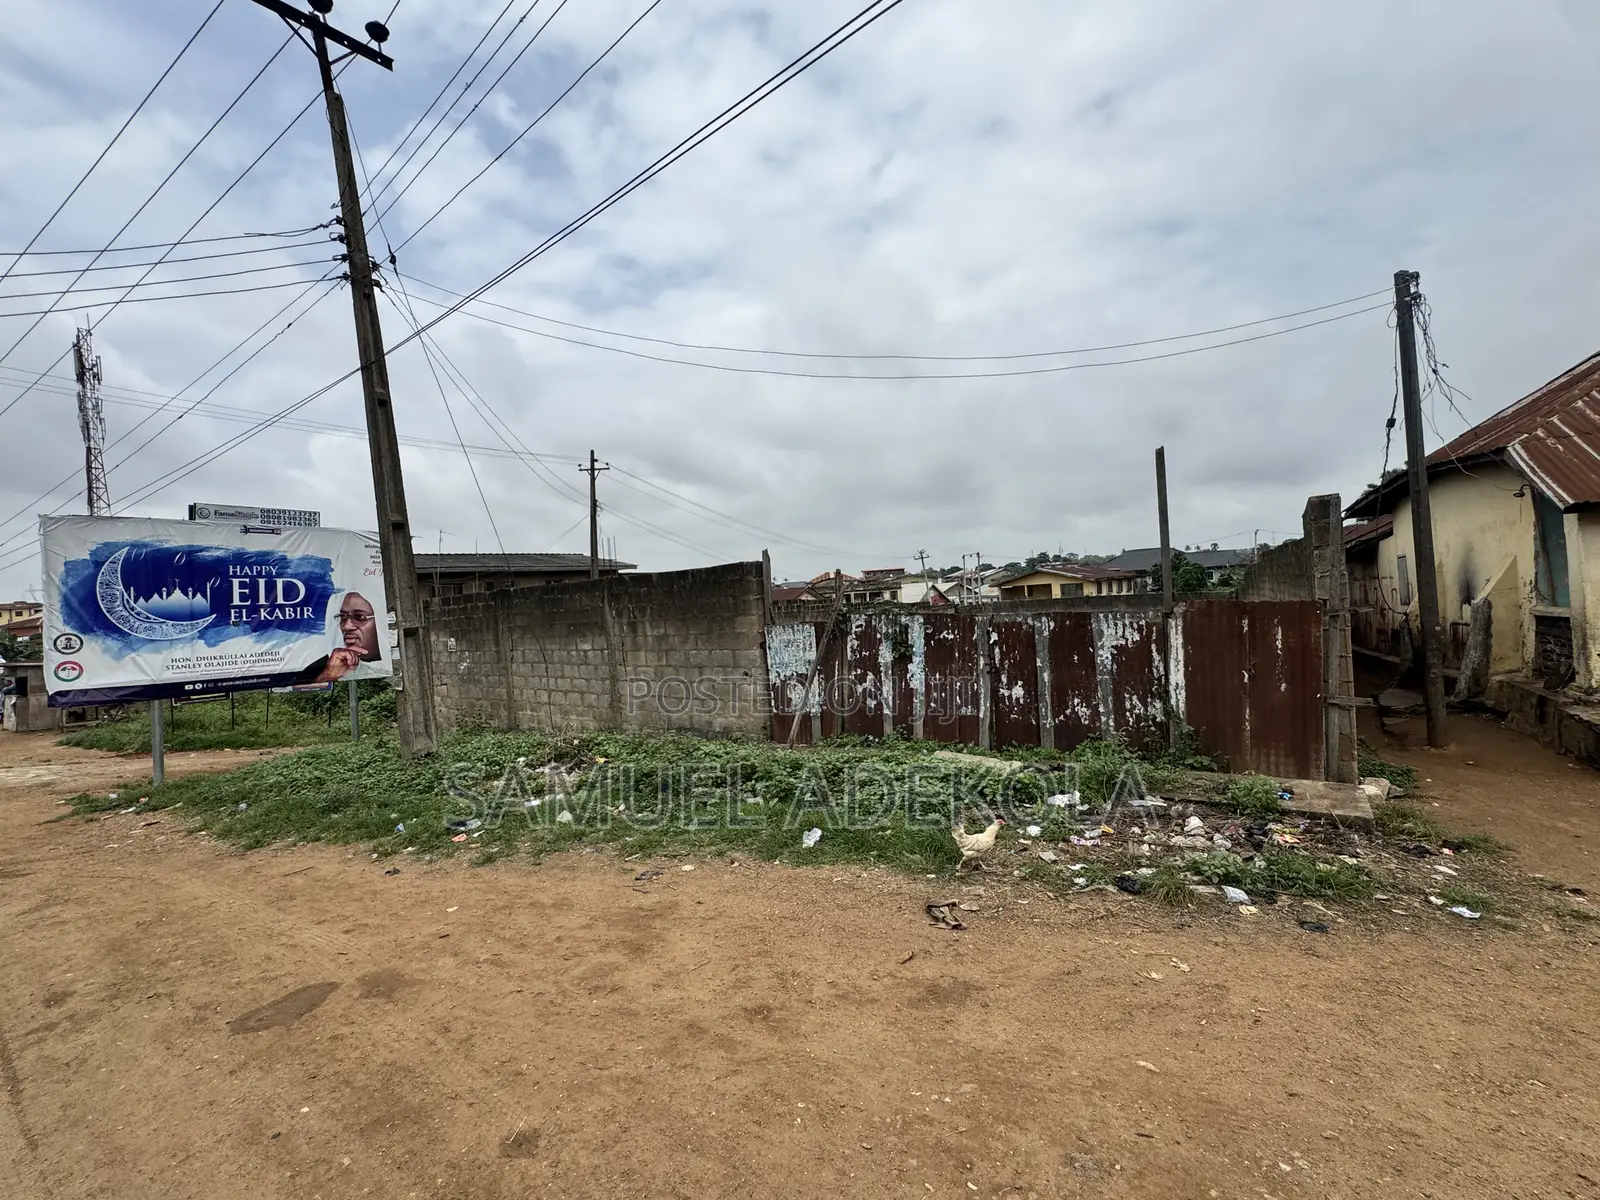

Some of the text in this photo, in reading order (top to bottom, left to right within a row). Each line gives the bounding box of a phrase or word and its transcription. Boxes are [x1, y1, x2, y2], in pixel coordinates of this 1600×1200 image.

[228, 565, 279, 576] HAPPY
[229, 578, 306, 606] EID
[229, 606, 316, 622] EL-KABIR
[249, 651, 280, 659] ADEDEJI
[165, 662, 204, 671] STANLEY
[204, 659, 239, 668] OLAJIDE
